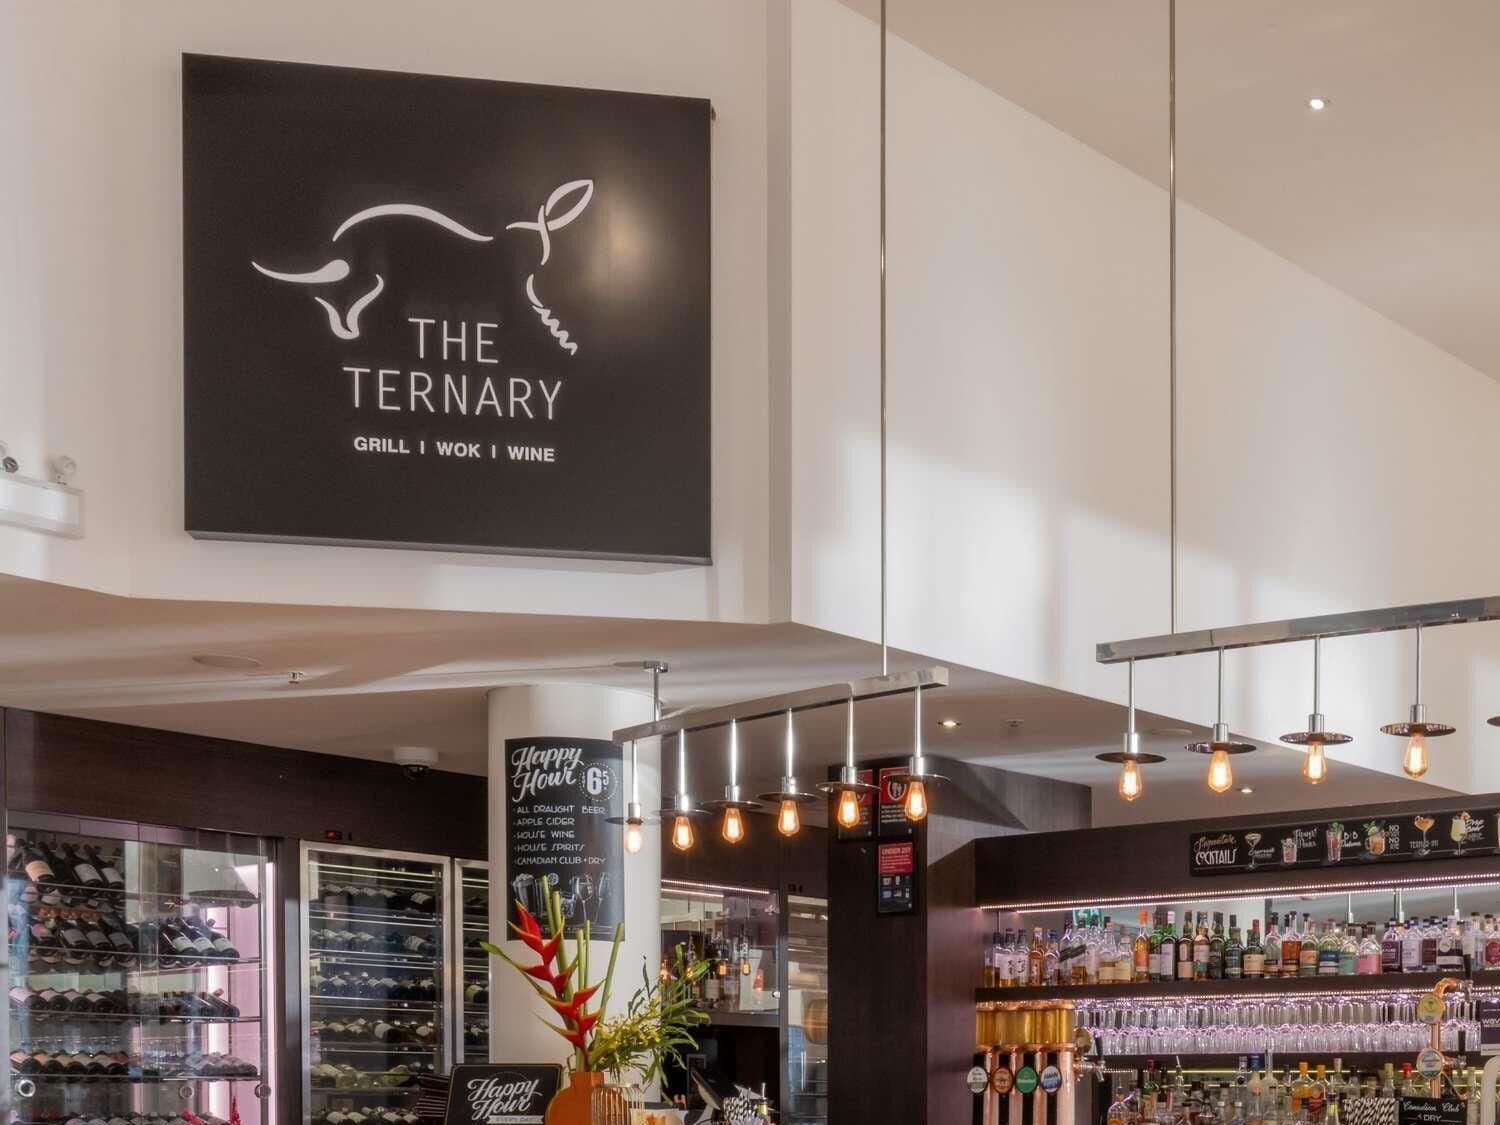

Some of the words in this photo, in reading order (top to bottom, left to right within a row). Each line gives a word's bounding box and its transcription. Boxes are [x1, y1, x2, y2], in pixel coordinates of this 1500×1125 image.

[408, 318, 498, 364] THE
[343, 367, 562, 420] TERNARY
[353, 436, 410, 454] GRILL
[436, 442, 481, 458] WOK
[508, 446, 555, 462] WINE
[511, 745, 584, 778] Happy
[512, 766, 577, 802] Hour
[517, 806, 530, 814] ALL
[533, 805, 576, 814] DRAUGHT
[582, 806, 606, 814] BEER
[517, 817, 543, 826] APPLE
[546, 817, 575, 826] CIDER
[517, 830, 545, 839] HOUSE
[551, 830, 575, 838] WINE
[517, 844, 547, 852] HOUSE
[551, 844, 584, 852] SPIRITS
[1195, 848, 1238, 865] COCKTAILS
[517, 856, 557, 865] CANADIAN
[559, 856, 582, 864] CLUB
[589, 856, 606, 864] DRY
[467, 1078, 543, 1102] Happy
[471, 1096, 531, 1120] Hour
[1403, 1101, 1437, 1112] Canadian
